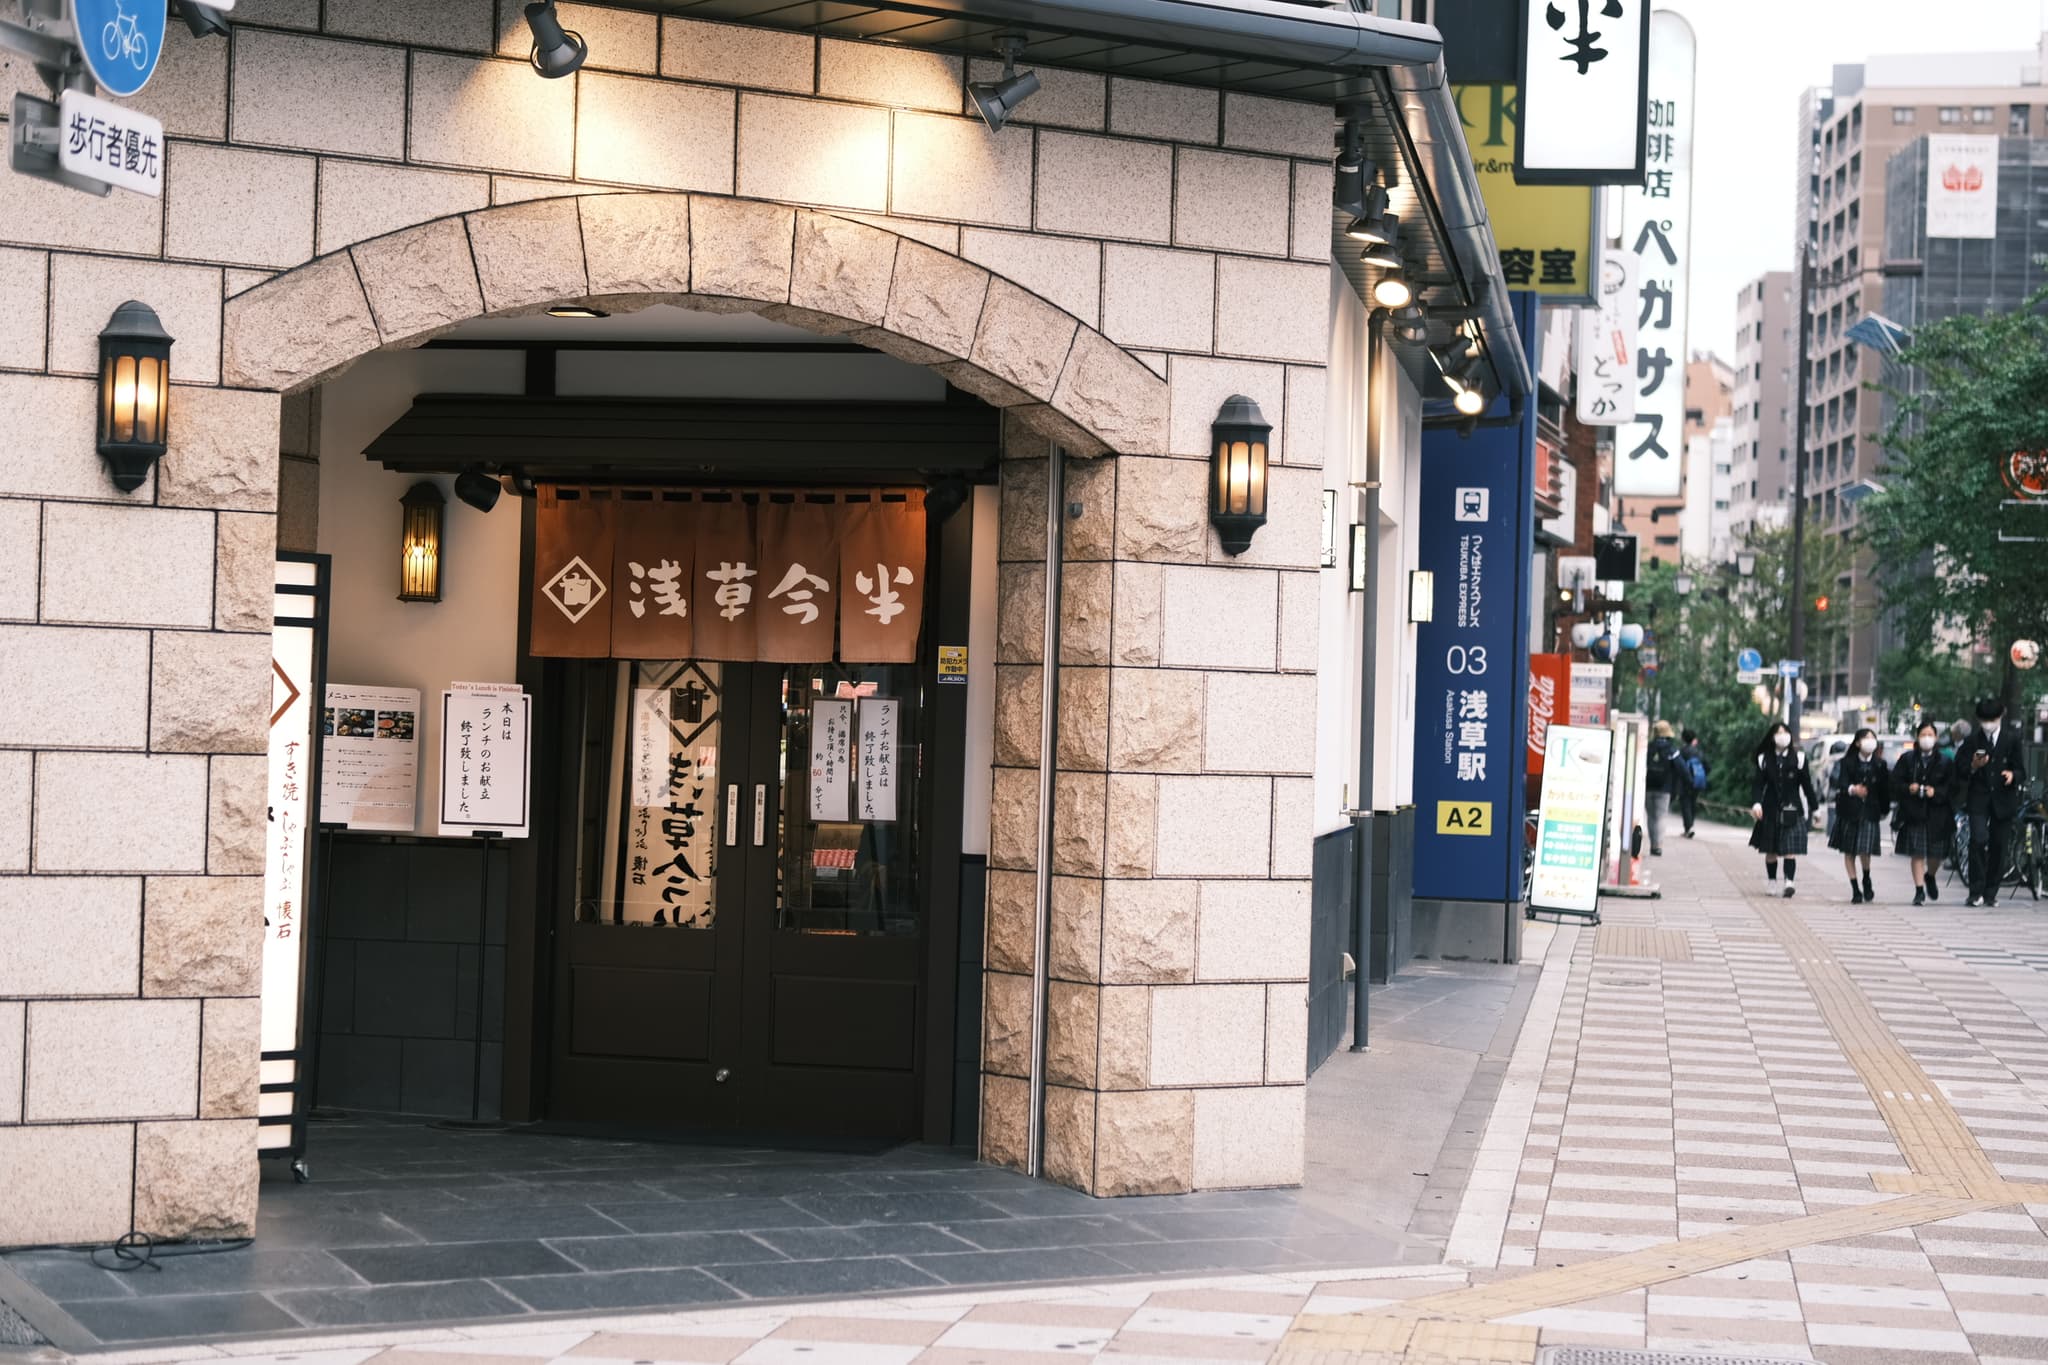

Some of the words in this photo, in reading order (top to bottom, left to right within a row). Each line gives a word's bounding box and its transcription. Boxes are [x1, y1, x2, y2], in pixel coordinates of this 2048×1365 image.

[68, 111, 158, 179] 歩行者優先
[1643, 99, 1675, 198] 珈琲店
[1629, 218, 1677, 460] ペガサス
[1459, 534, 1469, 581] TSUKUBA
[1469, 535, 1483, 628] つくばエクスプレス
[627, 558, 915, 625] 浅草今半
[1458, 583, 1468, 628] EXPRESS
[1446, 645, 1487, 675] 03
[328, 692, 356, 700] メニュー
[501, 702, 513, 740] 本日は
[1446, 689, 1455, 729] Asakusa
[480, 708, 491, 800] ランチのお献立
[879, 704, 890, 788] ランチお献立は
[1445, 731, 1454, 764] Station
[1457, 690, 1488, 781] 浅草駅
[281, 740, 300, 802] すき焼
[459, 720, 473, 819] 終了致しました。
[864, 730, 876, 819] 終了致しました。
[279, 810, 297, 891] しゃぶしゃぶ
[1446, 807, 1482, 828] A2
[275, 900, 294, 940] 懐石
